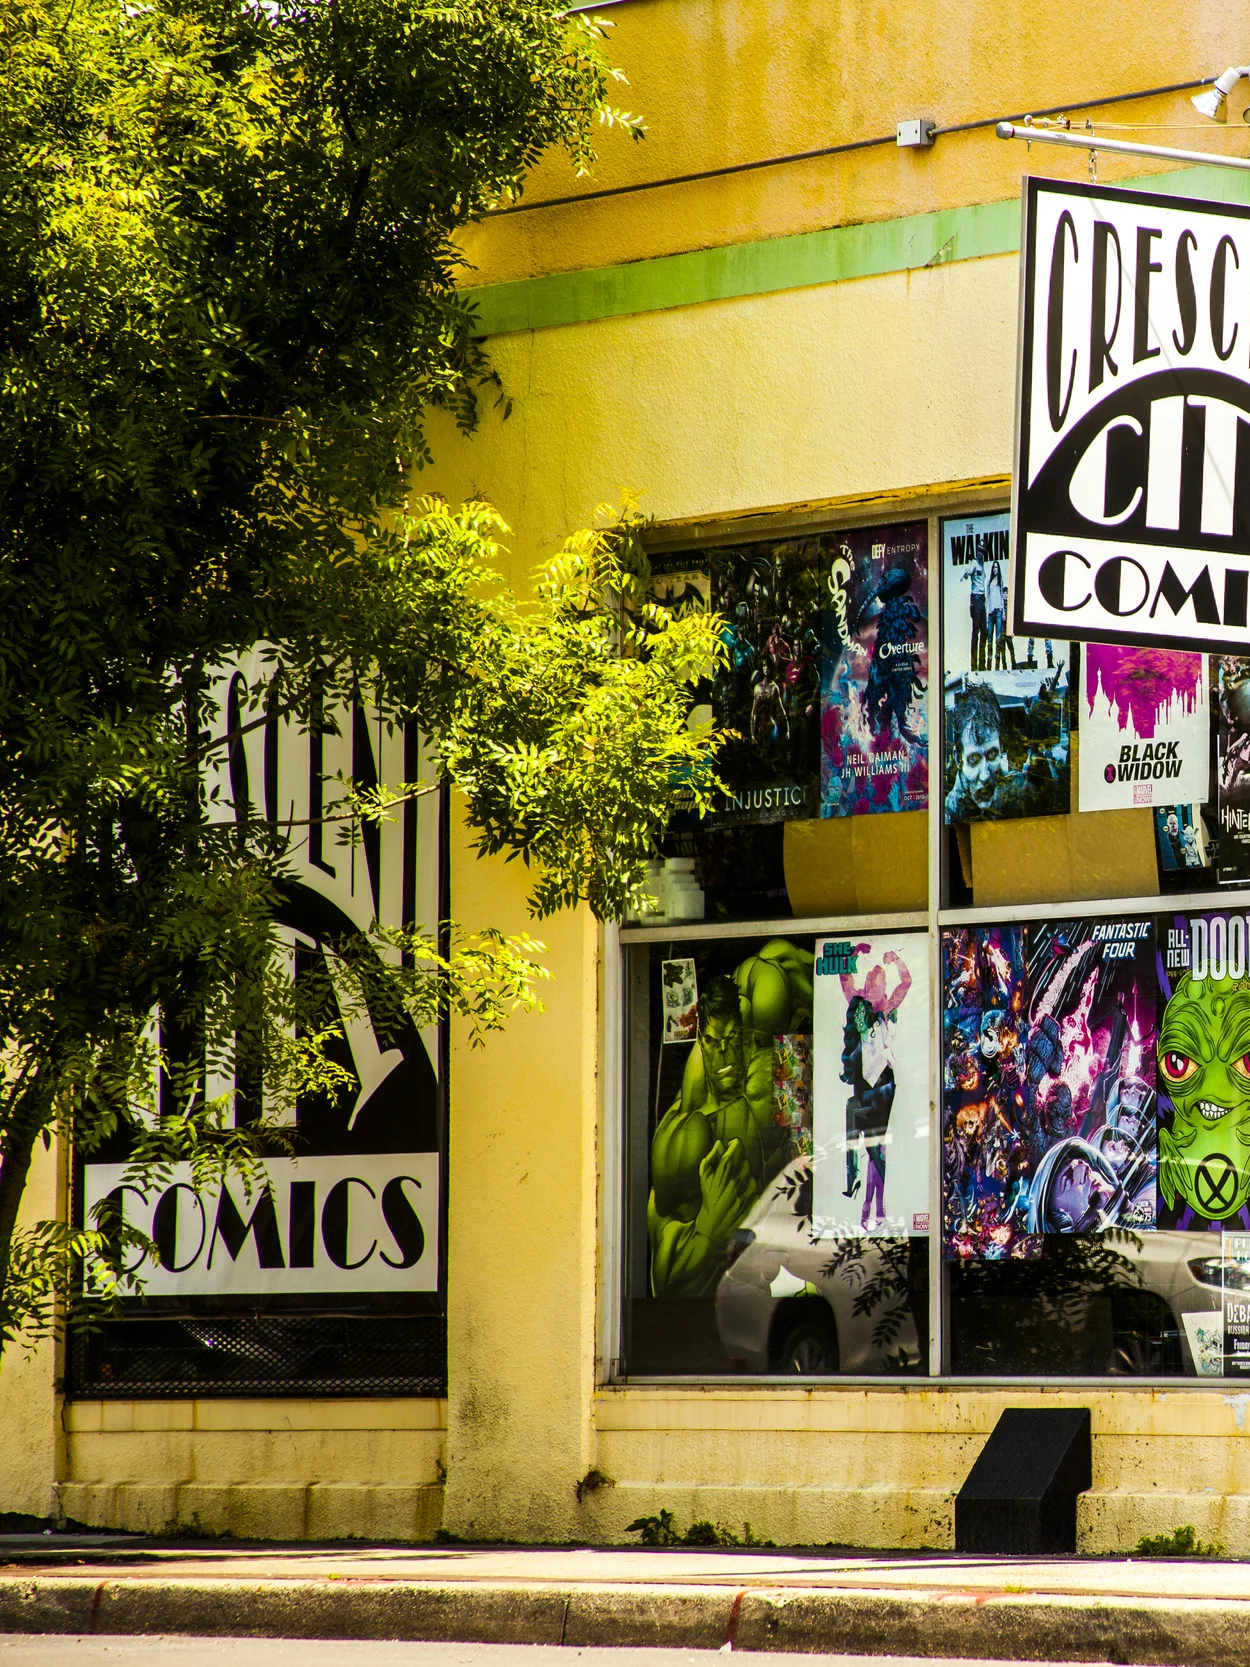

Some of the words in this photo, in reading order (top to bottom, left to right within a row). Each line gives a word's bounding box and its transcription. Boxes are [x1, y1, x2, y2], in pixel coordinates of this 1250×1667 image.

[887, 543, 920, 555] ENTROPY
[828, 558, 868, 657] SANDMAN
[879, 641, 925, 659] Overture
[846, 753, 865, 765] NEIL
[869, 750, 905, 763] GAIMAN
[1119, 741, 1180, 763] BLACK
[841, 768, 851, 778] JH
[855, 763, 898, 777] WILLIAMS
[1117, 760, 1183, 782] WIDOW
[1092, 922, 1151, 941] FANTASTIC
[823, 942, 856, 957] SHE-
[1102, 942, 1136, 959] FOUR
[1167, 949, 1190, 968] NEW
[816, 956, 859, 976] HULK
[97, 1176, 425, 1274] COMICS
